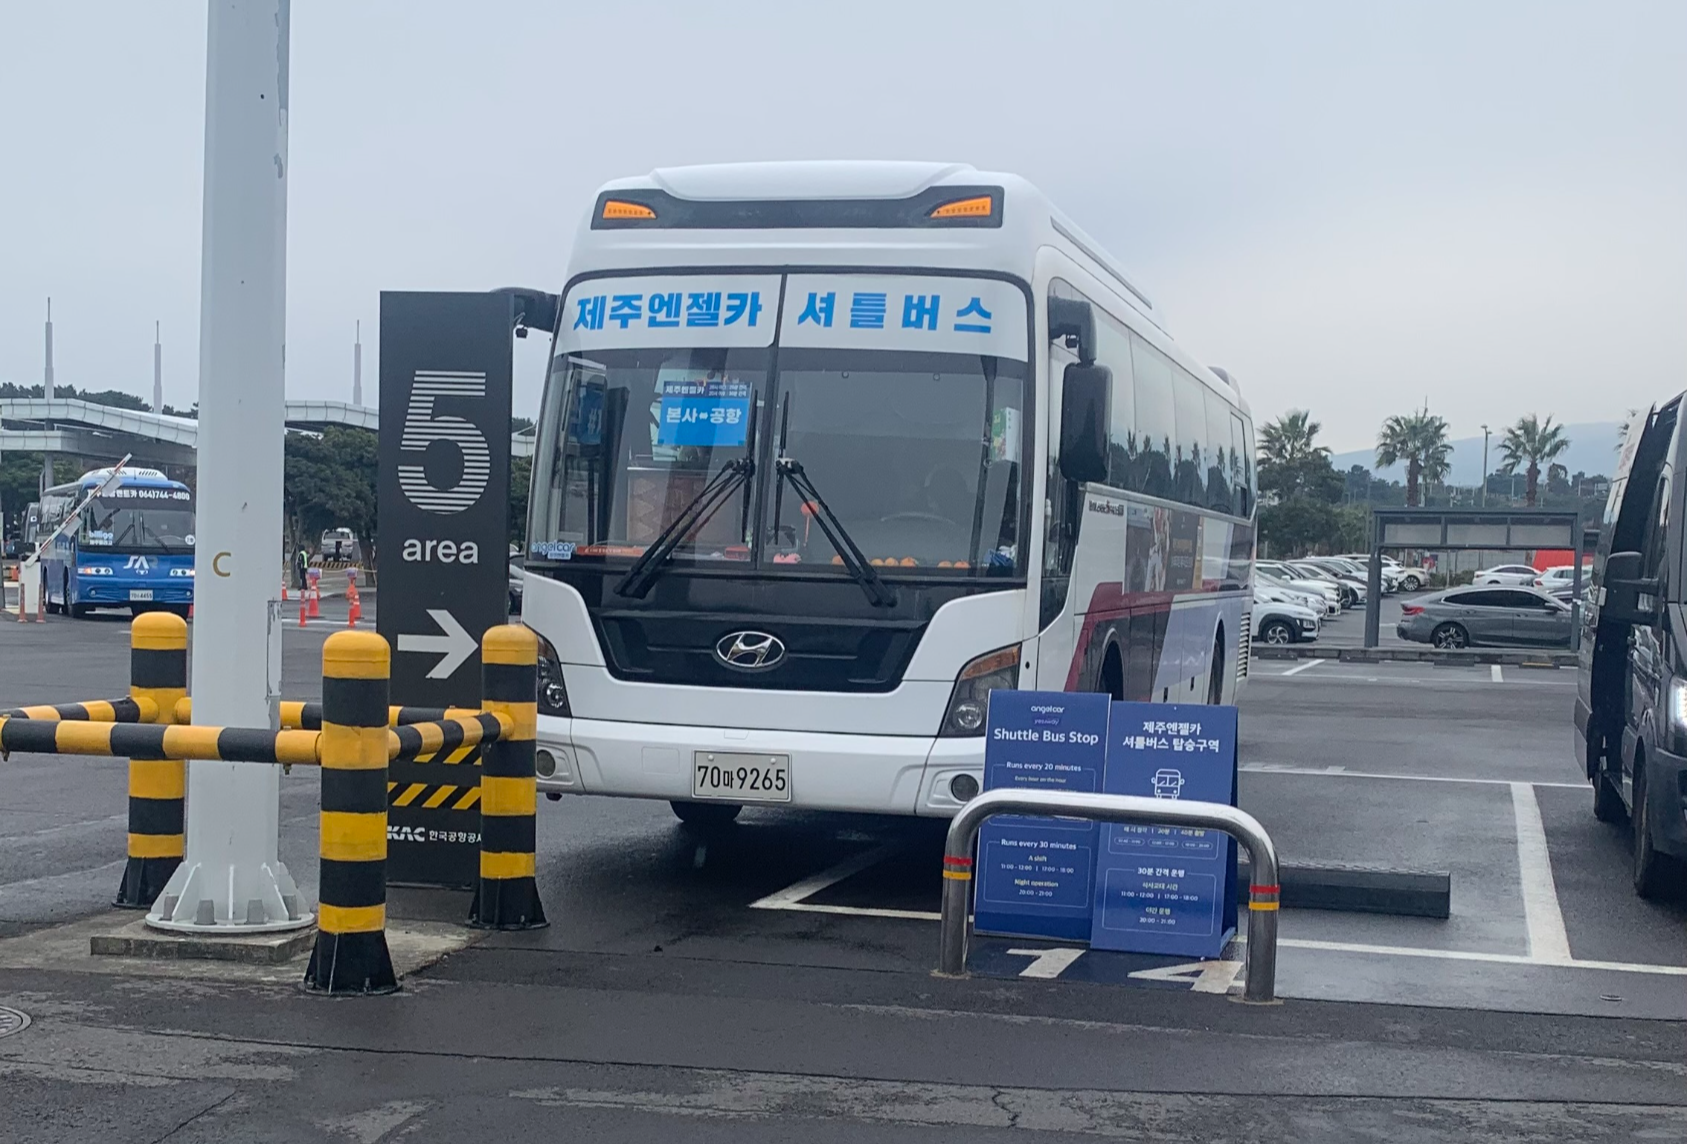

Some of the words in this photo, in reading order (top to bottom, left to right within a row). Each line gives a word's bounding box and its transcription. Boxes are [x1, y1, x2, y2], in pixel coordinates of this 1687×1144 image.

[573, 291, 763, 331] 제주엔젤카
[797, 291, 992, 333] 셔틀버스
[398, 370, 491, 515] 5
[402, 538, 479, 564] area
[531, 540, 576, 555] angelcar
[213, 552, 231, 577] C
[1031, 705, 1065, 714] angelcar
[994, 728, 1039, 741] Shuttle
[1042, 730, 1066, 742] Bus
[1068, 731, 1099, 746] Stop
[1143, 721, 1202, 736] 제주엔젤카
[1122, 735, 1169, 750] 셔틀버스
[1172, 737, 1220, 753] 탑승구역
[1006, 761, 1023, 769] Runs
[1024, 763, 1043, 771] every
[1044, 763, 1054, 771] 20
[1055, 764, 1082, 772] minutes
[697, 765, 786, 791] 70마9265
[386, 825, 426, 842] KAC
[1019, 840, 1038, 849] every
[1050, 842, 1077, 850] minutes
[1137, 867, 1154, 876] 30분
